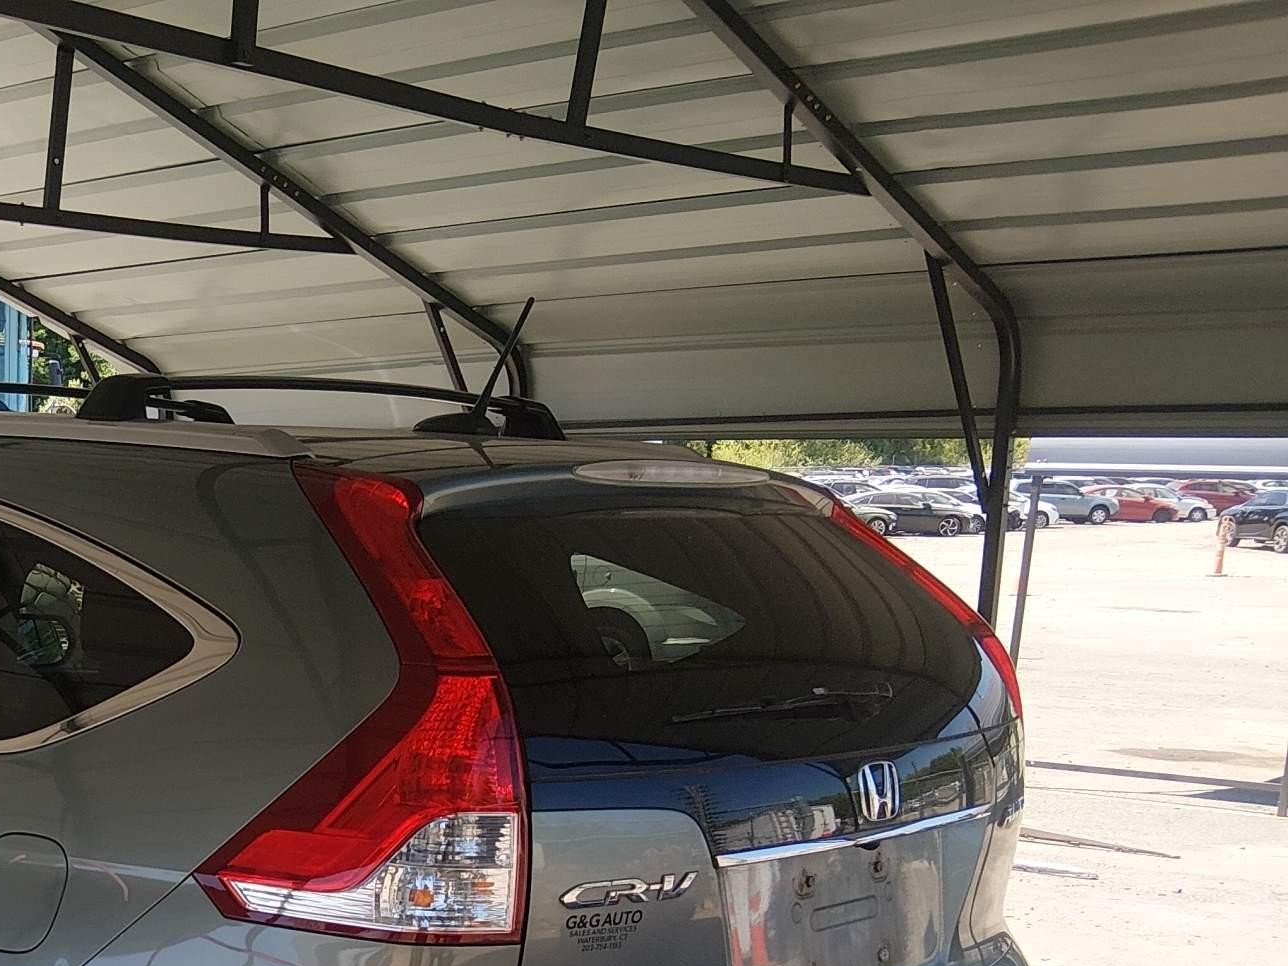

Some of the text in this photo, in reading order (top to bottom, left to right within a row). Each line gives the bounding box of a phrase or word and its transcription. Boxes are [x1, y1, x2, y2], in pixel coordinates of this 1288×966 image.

[558, 870, 699, 909] CR-V
[566, 910, 642, 929] G&G AUTO
